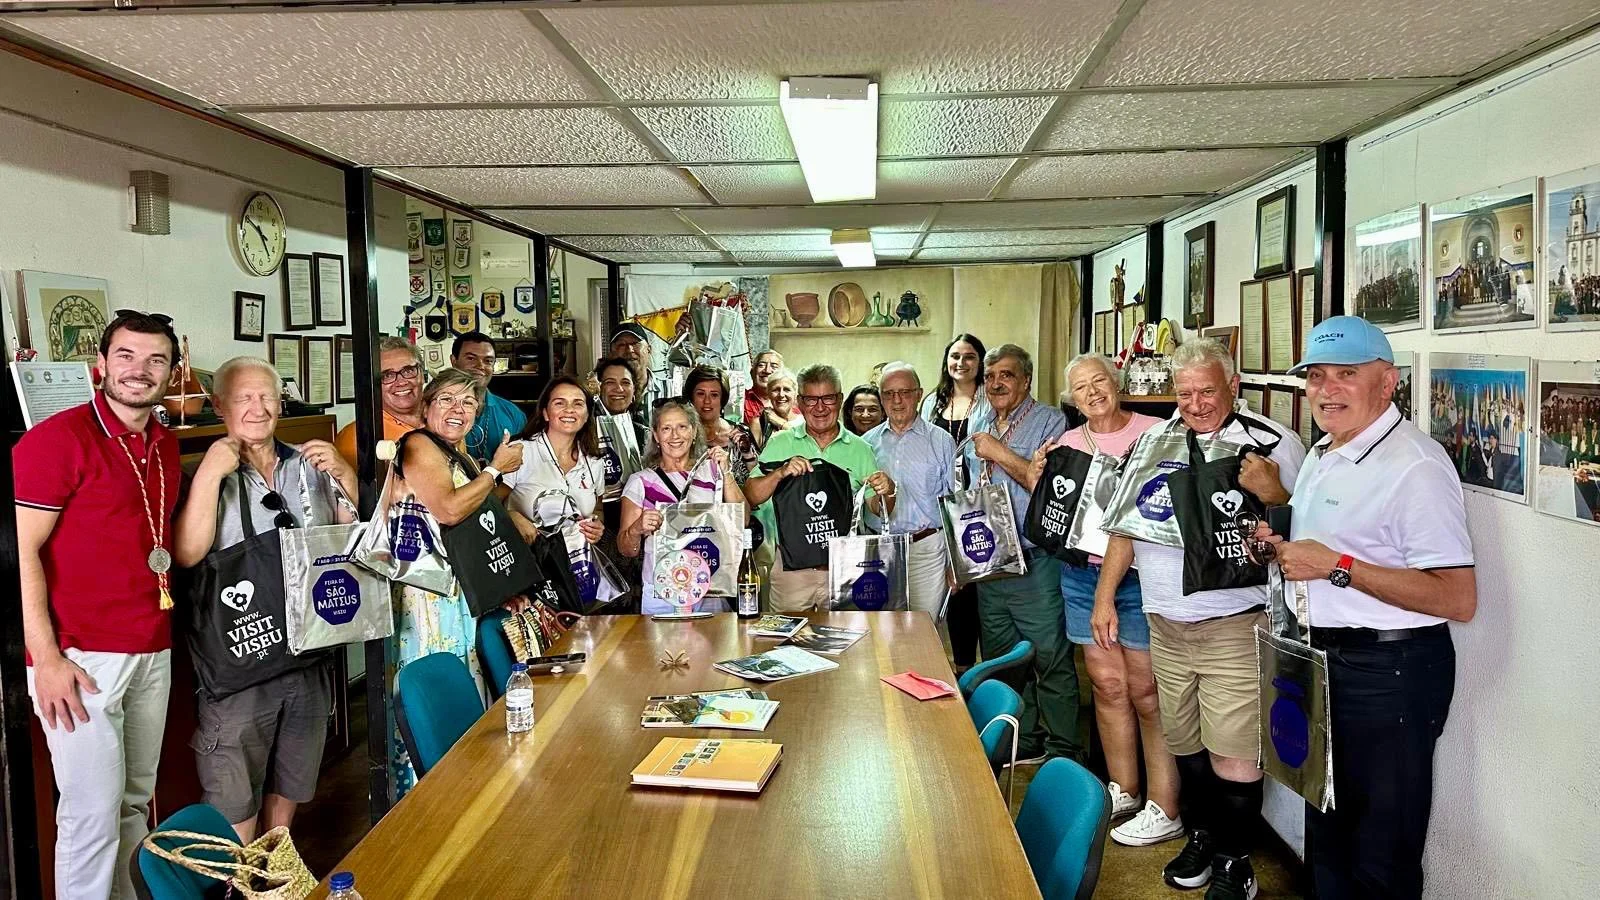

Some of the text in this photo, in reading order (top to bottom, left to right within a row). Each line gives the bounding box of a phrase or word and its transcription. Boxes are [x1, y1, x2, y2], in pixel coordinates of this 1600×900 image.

[250, 253, 256, 261] 7
[1314, 333, 1344, 342] COACH
[1139, 495, 1172, 507] MATEU
[1045, 504, 1069, 523] VISIT
[805, 519, 835, 533] VISIT
[1041, 515, 1067, 535] VISEU
[970, 533, 985, 544] SÃO
[485, 541, 508, 560] VISIT
[966, 540, 993, 552] MATEUS
[488, 552, 514, 573] VISEU
[1236, 556, 1248, 567] .pt
[325, 585, 346, 598] SÃO
[317, 594, 357, 610] MATEUS
[233, 611, 262, 626] www.
[227, 615, 274, 643] VISIT
[229, 629, 283, 659] VISEU
[256, 650, 269, 660] .pt
